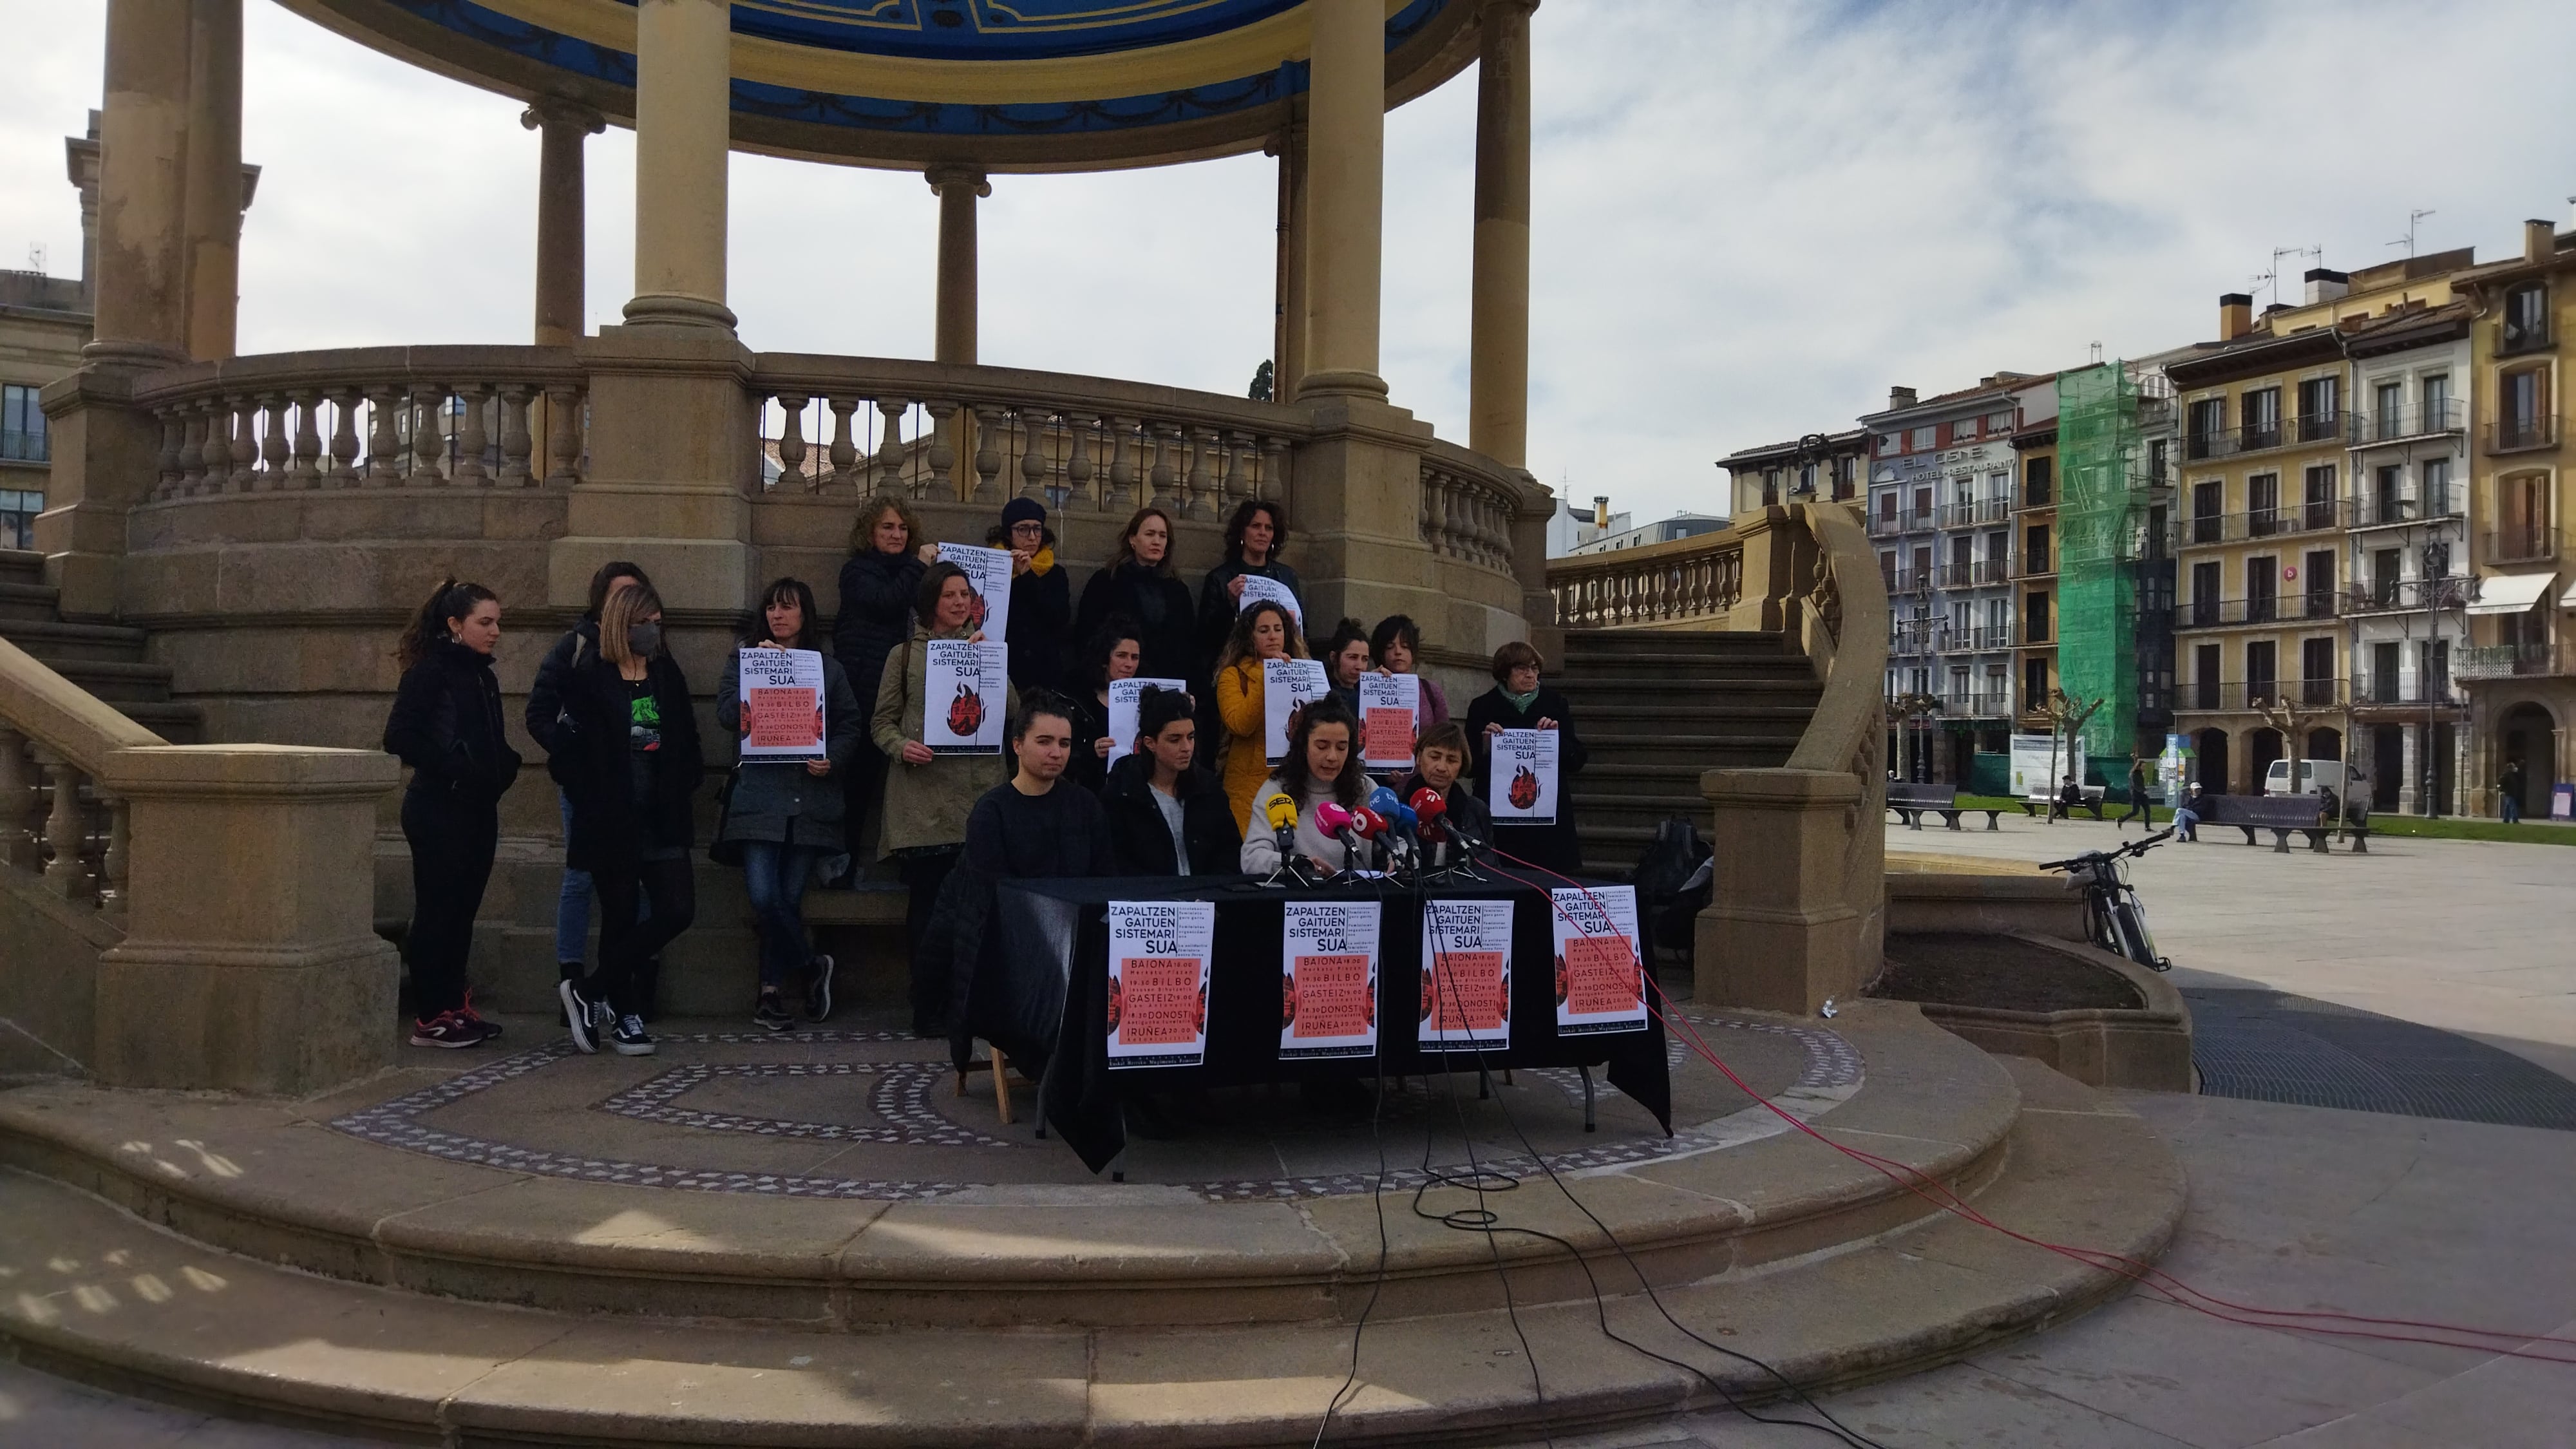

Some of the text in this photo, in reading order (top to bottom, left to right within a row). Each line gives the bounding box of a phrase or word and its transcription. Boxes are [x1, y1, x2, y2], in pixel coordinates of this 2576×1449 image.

[1902, 447, 1983, 469] EL CISNE
[941, 545, 986, 556] ZAPALTZEN
[950, 553, 985, 564] GAITUEN
[956, 561, 985, 571] TEMARI
[956, 667, 981, 677] SUA
[769, 676, 796, 685] SUA
[1291, 683, 1312, 692] SUA
[1380, 696, 1399, 705] SUA
[1269, 797, 1293, 810] SER
[1553, 891, 1605, 902] ZAPALTZEN
[1425, 905, 1481, 914] ZAPALTZEN
[1566, 902, 1606, 911] GAITUEN
[1111, 907, 1175, 916] ZAPALTZEN
[1286, 907, 1345, 916] ZAPALTZEN
[1437, 915, 1481, 924] GAITUEN
[1558, 911, 1606, 922] SISTEMARI
[1125, 918, 1175, 927] GAITUEN
[1298, 918, 1345, 927] GAITUEN
[1584, 921, 1611, 933] SUA
[1115, 929, 1175, 938] SISTEMARI
[1289, 928, 1345, 938] SISTEMARI
[1429, 925, 1479, 934] SISTEMARI
[1317, 938, 1347, 951] SUA
[1454, 936, 1482, 948] SUA
[1146, 940, 1178, 954] SUA
[1304, 957, 1342, 966] BAIONA
[1594, 953, 1627, 962] BILBO
[1131, 960, 1172, 969] BAIONA
[1324, 973, 1360, 981] BILBO
[1460, 969, 1495, 978] BILBO
[1574, 969, 1614, 977] GASTEIZ
[1153, 978, 1191, 986] BILBO
[1303, 989, 1343, 998] GASTEIZ
[1440, 985, 1479, 993] GASTEIZ
[1129, 994, 1173, 1003] GASTEIZ
[1575, 998, 1612, 1007] IRUÑEA
[1321, 1005, 1361, 1014] DONOSTI
[1148, 1010, 1191, 1019] DONOSTI
[1302, 1019, 1340, 1030] IRUÑEA
[1128, 1025, 1167, 1036] IRUÑEA
